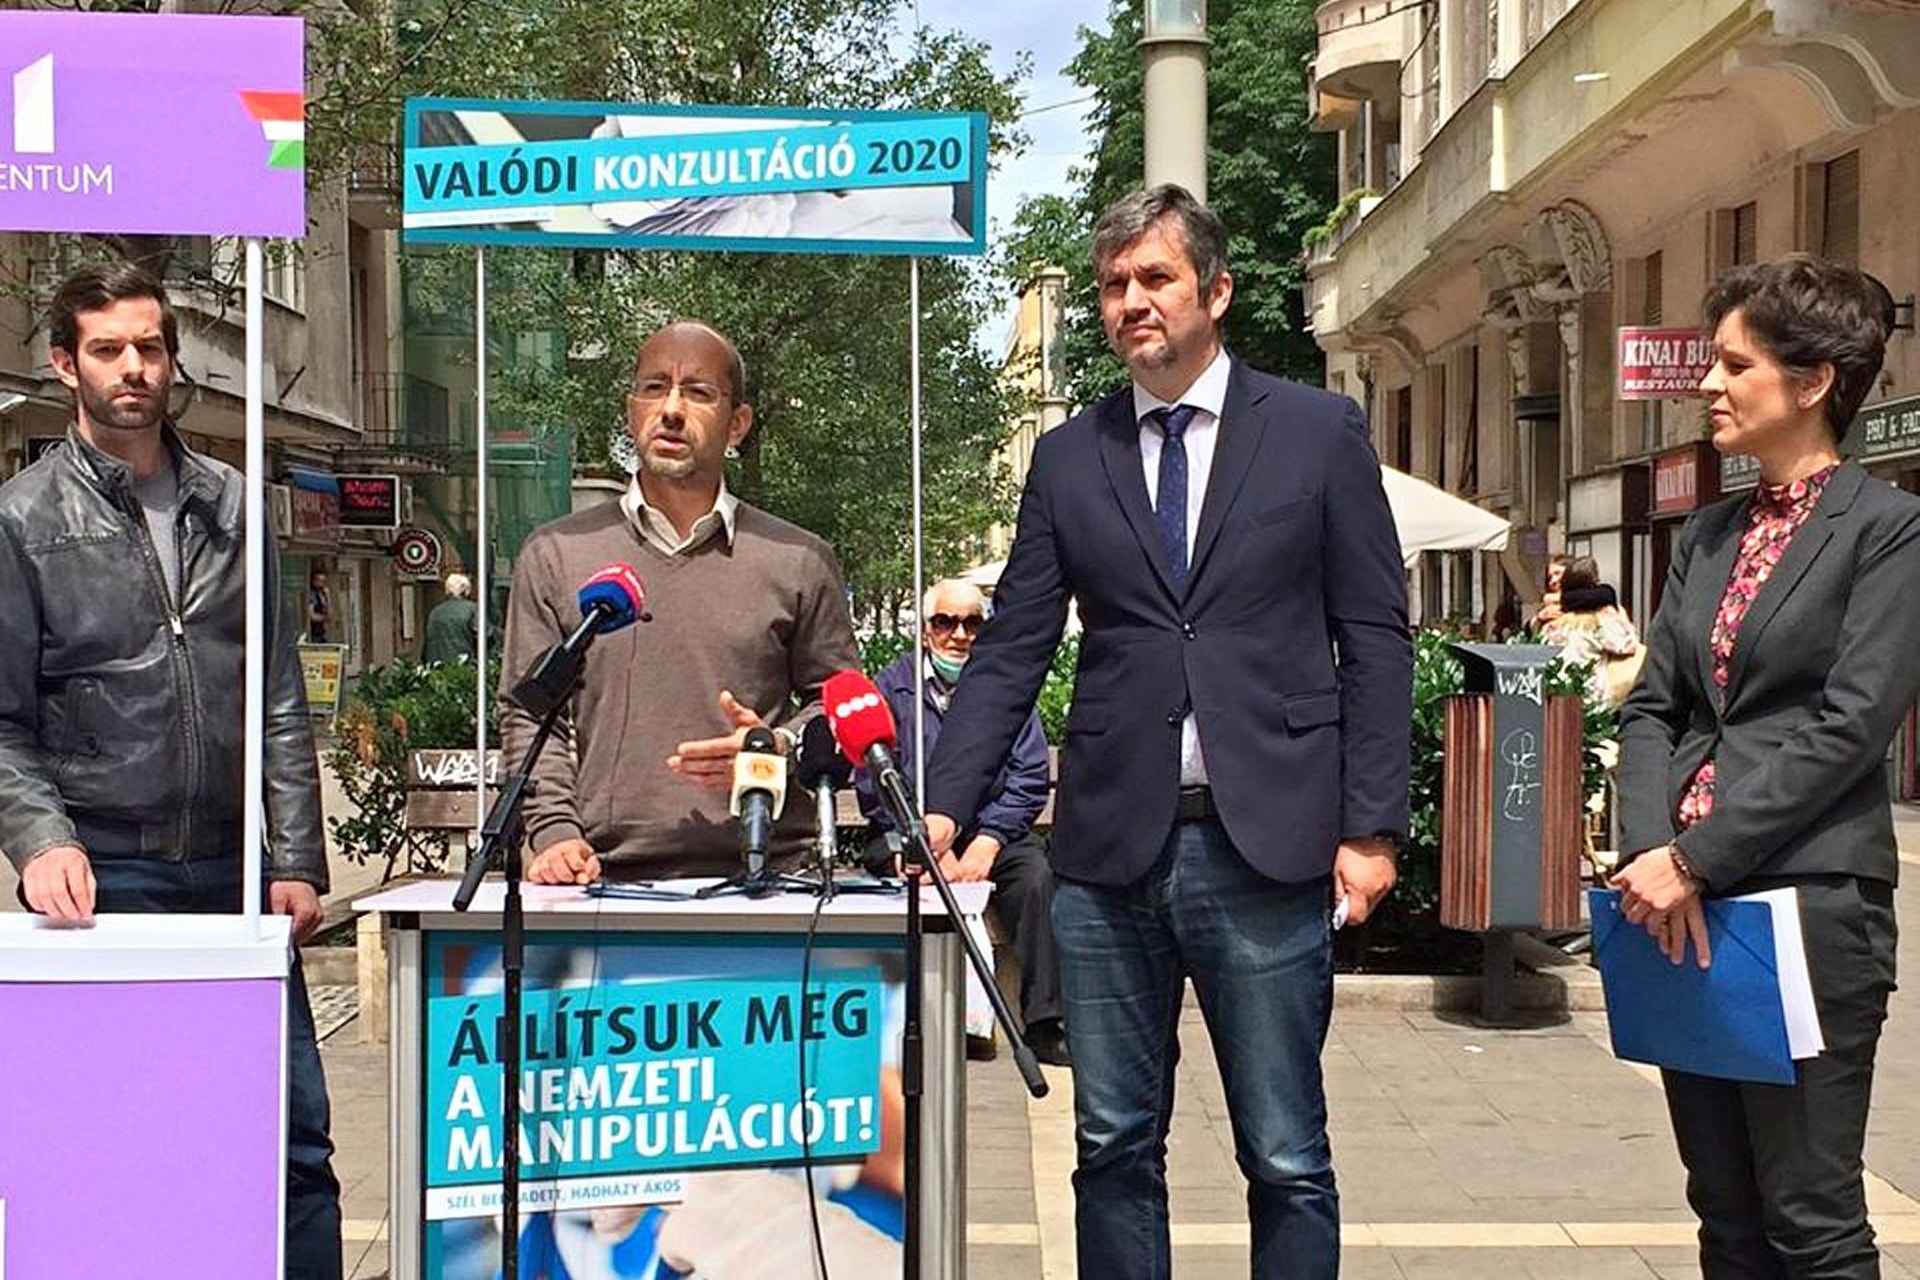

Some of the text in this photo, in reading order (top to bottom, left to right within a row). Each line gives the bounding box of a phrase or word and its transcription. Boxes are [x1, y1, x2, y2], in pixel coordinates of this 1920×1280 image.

[415, 133, 961, 200] VALÓDI KONZULTÁCIÓ 2020
[1624, 336, 1680, 367] KÍNAI
[743, 988, 869, 1046] MEG
[445, 1074, 486, 1121] A
[446, 1087, 874, 1172] MANIPULÁCIÓT!
[571, 1180, 638, 1200] HADHÁZY
[643, 1178, 681, 1194] ÁKOS
